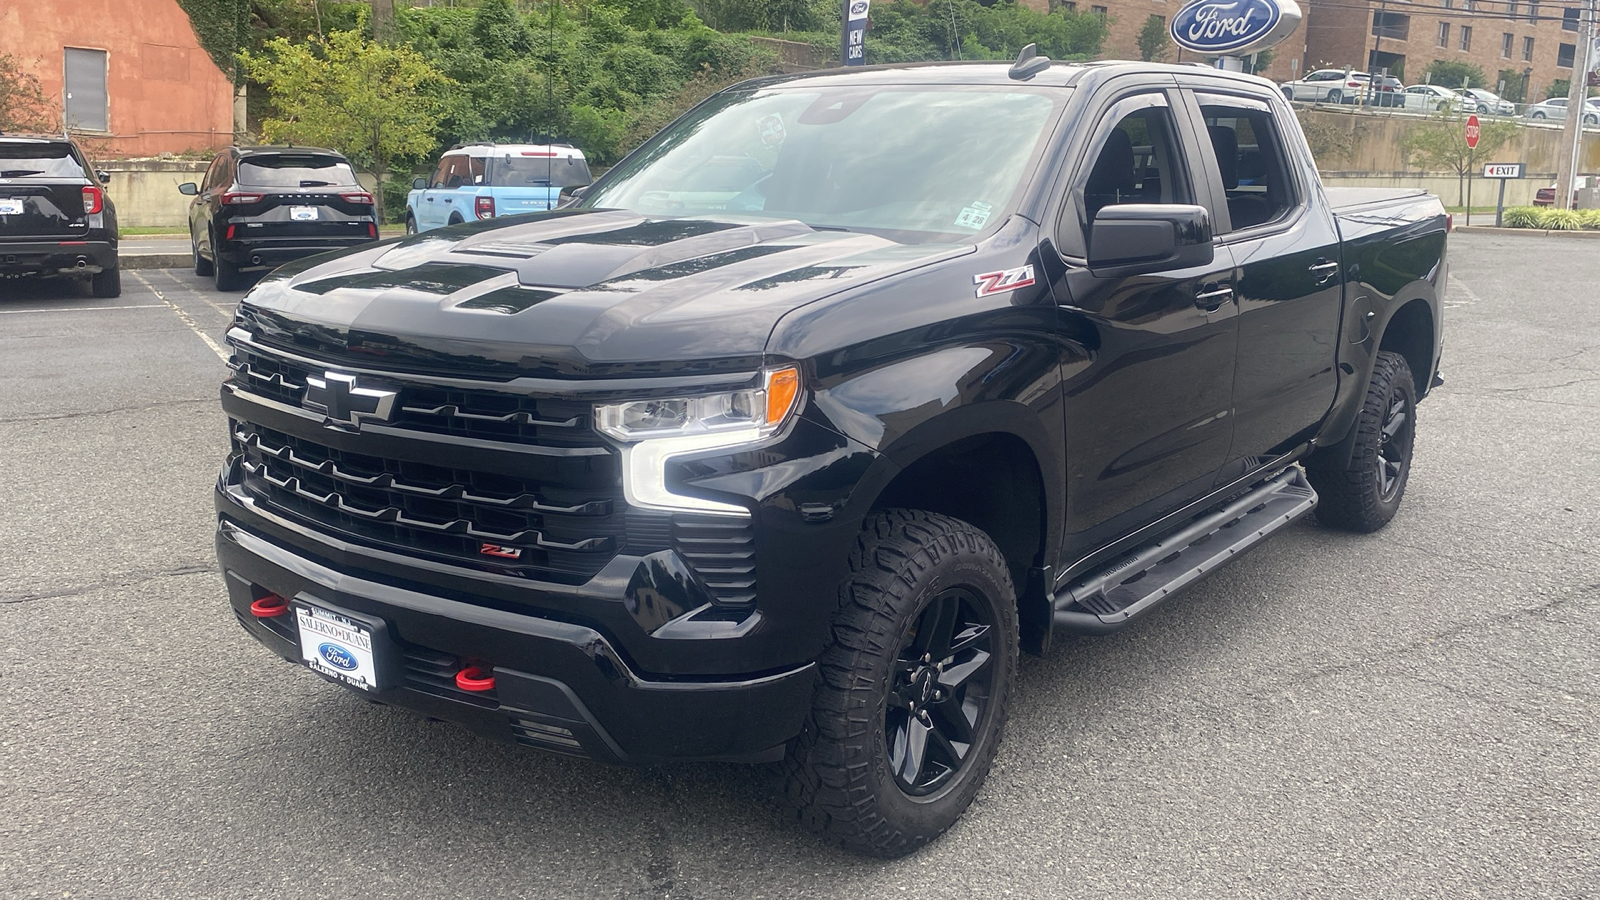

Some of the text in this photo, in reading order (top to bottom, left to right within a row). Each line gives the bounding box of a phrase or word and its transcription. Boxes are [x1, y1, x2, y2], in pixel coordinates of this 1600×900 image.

[1188, 2, 1255, 41] Ford
[849, 29, 863, 45] NEW
[848, 45, 863, 59] CARS
[1466, 126, 1479, 138] STOP
[1496, 166, 1516, 175] EXIT
[972, 216, 985, 224] 28
[973, 264, 1035, 298] Z71
[480, 544, 521, 559] Z71
[299, 617, 370, 649] SALERNO DUANE
[326, 647, 350, 667] Ford
[309, 662, 369, 691] SALERNO DUANE
